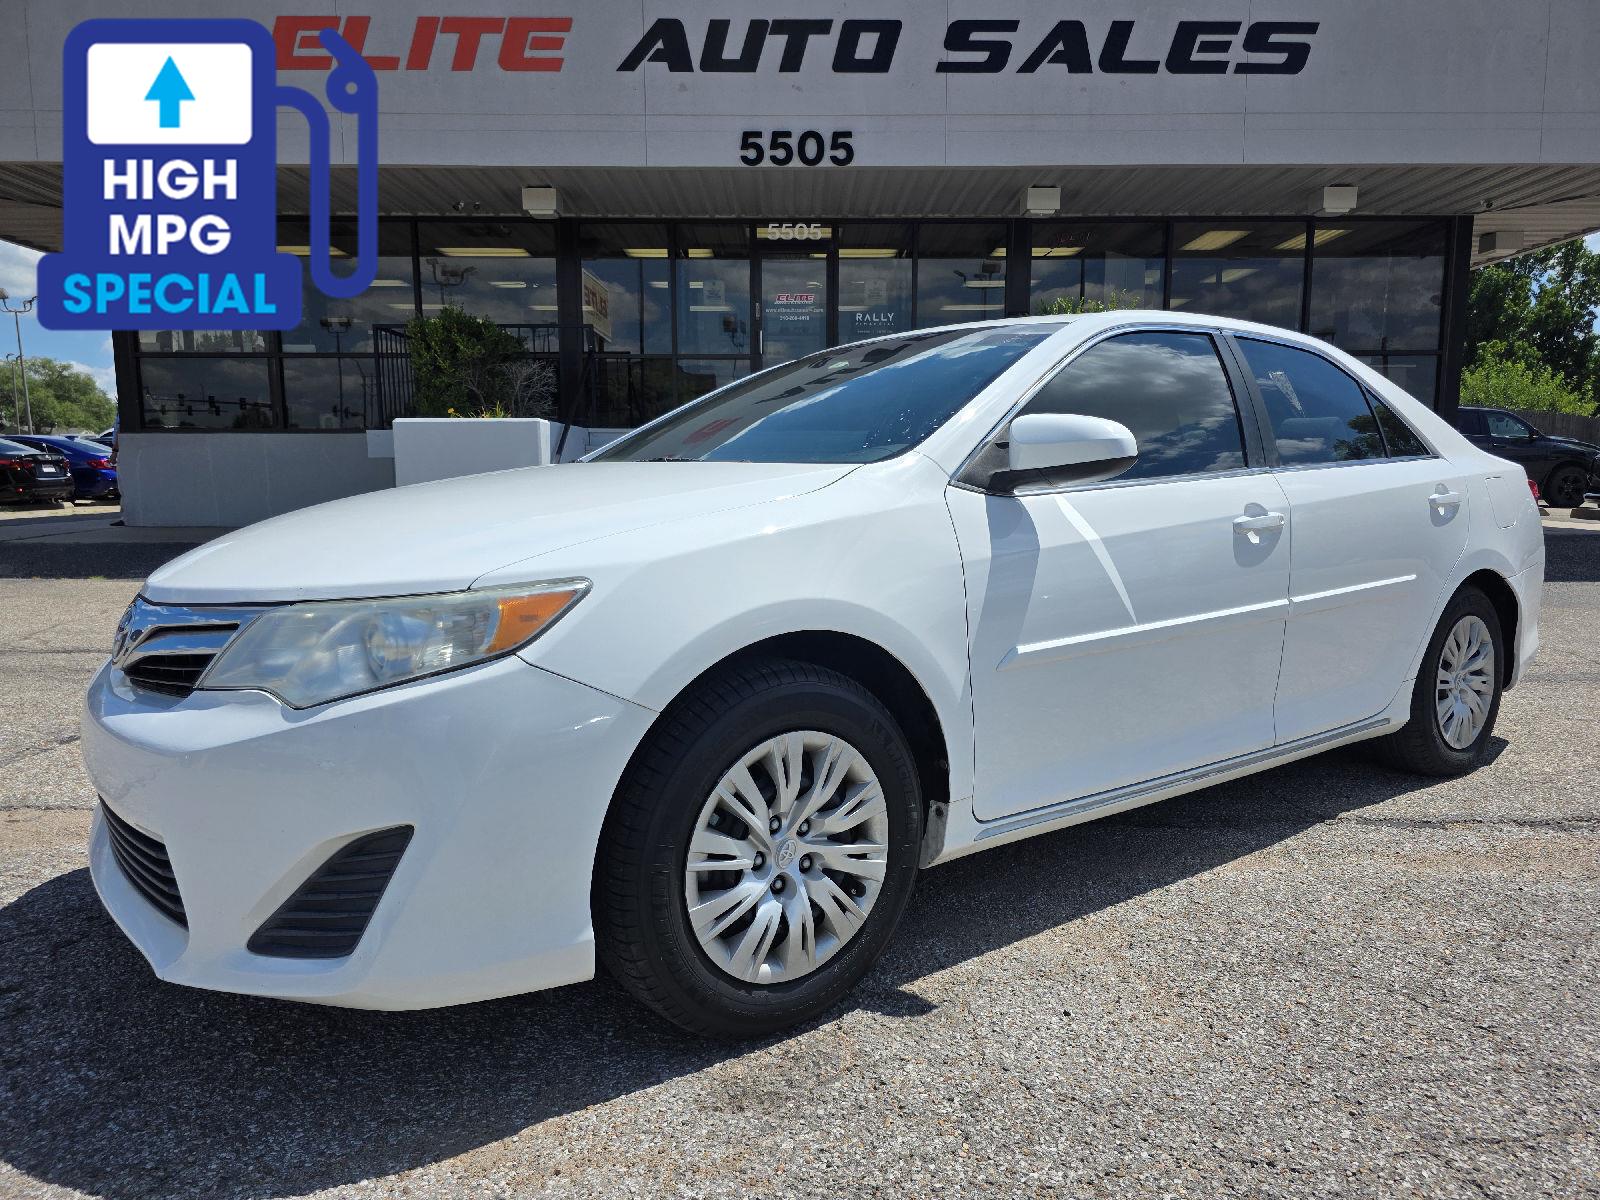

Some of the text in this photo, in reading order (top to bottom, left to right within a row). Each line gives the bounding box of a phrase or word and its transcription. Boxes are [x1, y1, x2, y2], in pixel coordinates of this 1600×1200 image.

[275, 15, 1320, 75] ELITE AUTO SALES
[739, 130, 854, 167] 5505
[767, 223, 823, 241] 5505
[855, 312, 895, 322] RALLY
